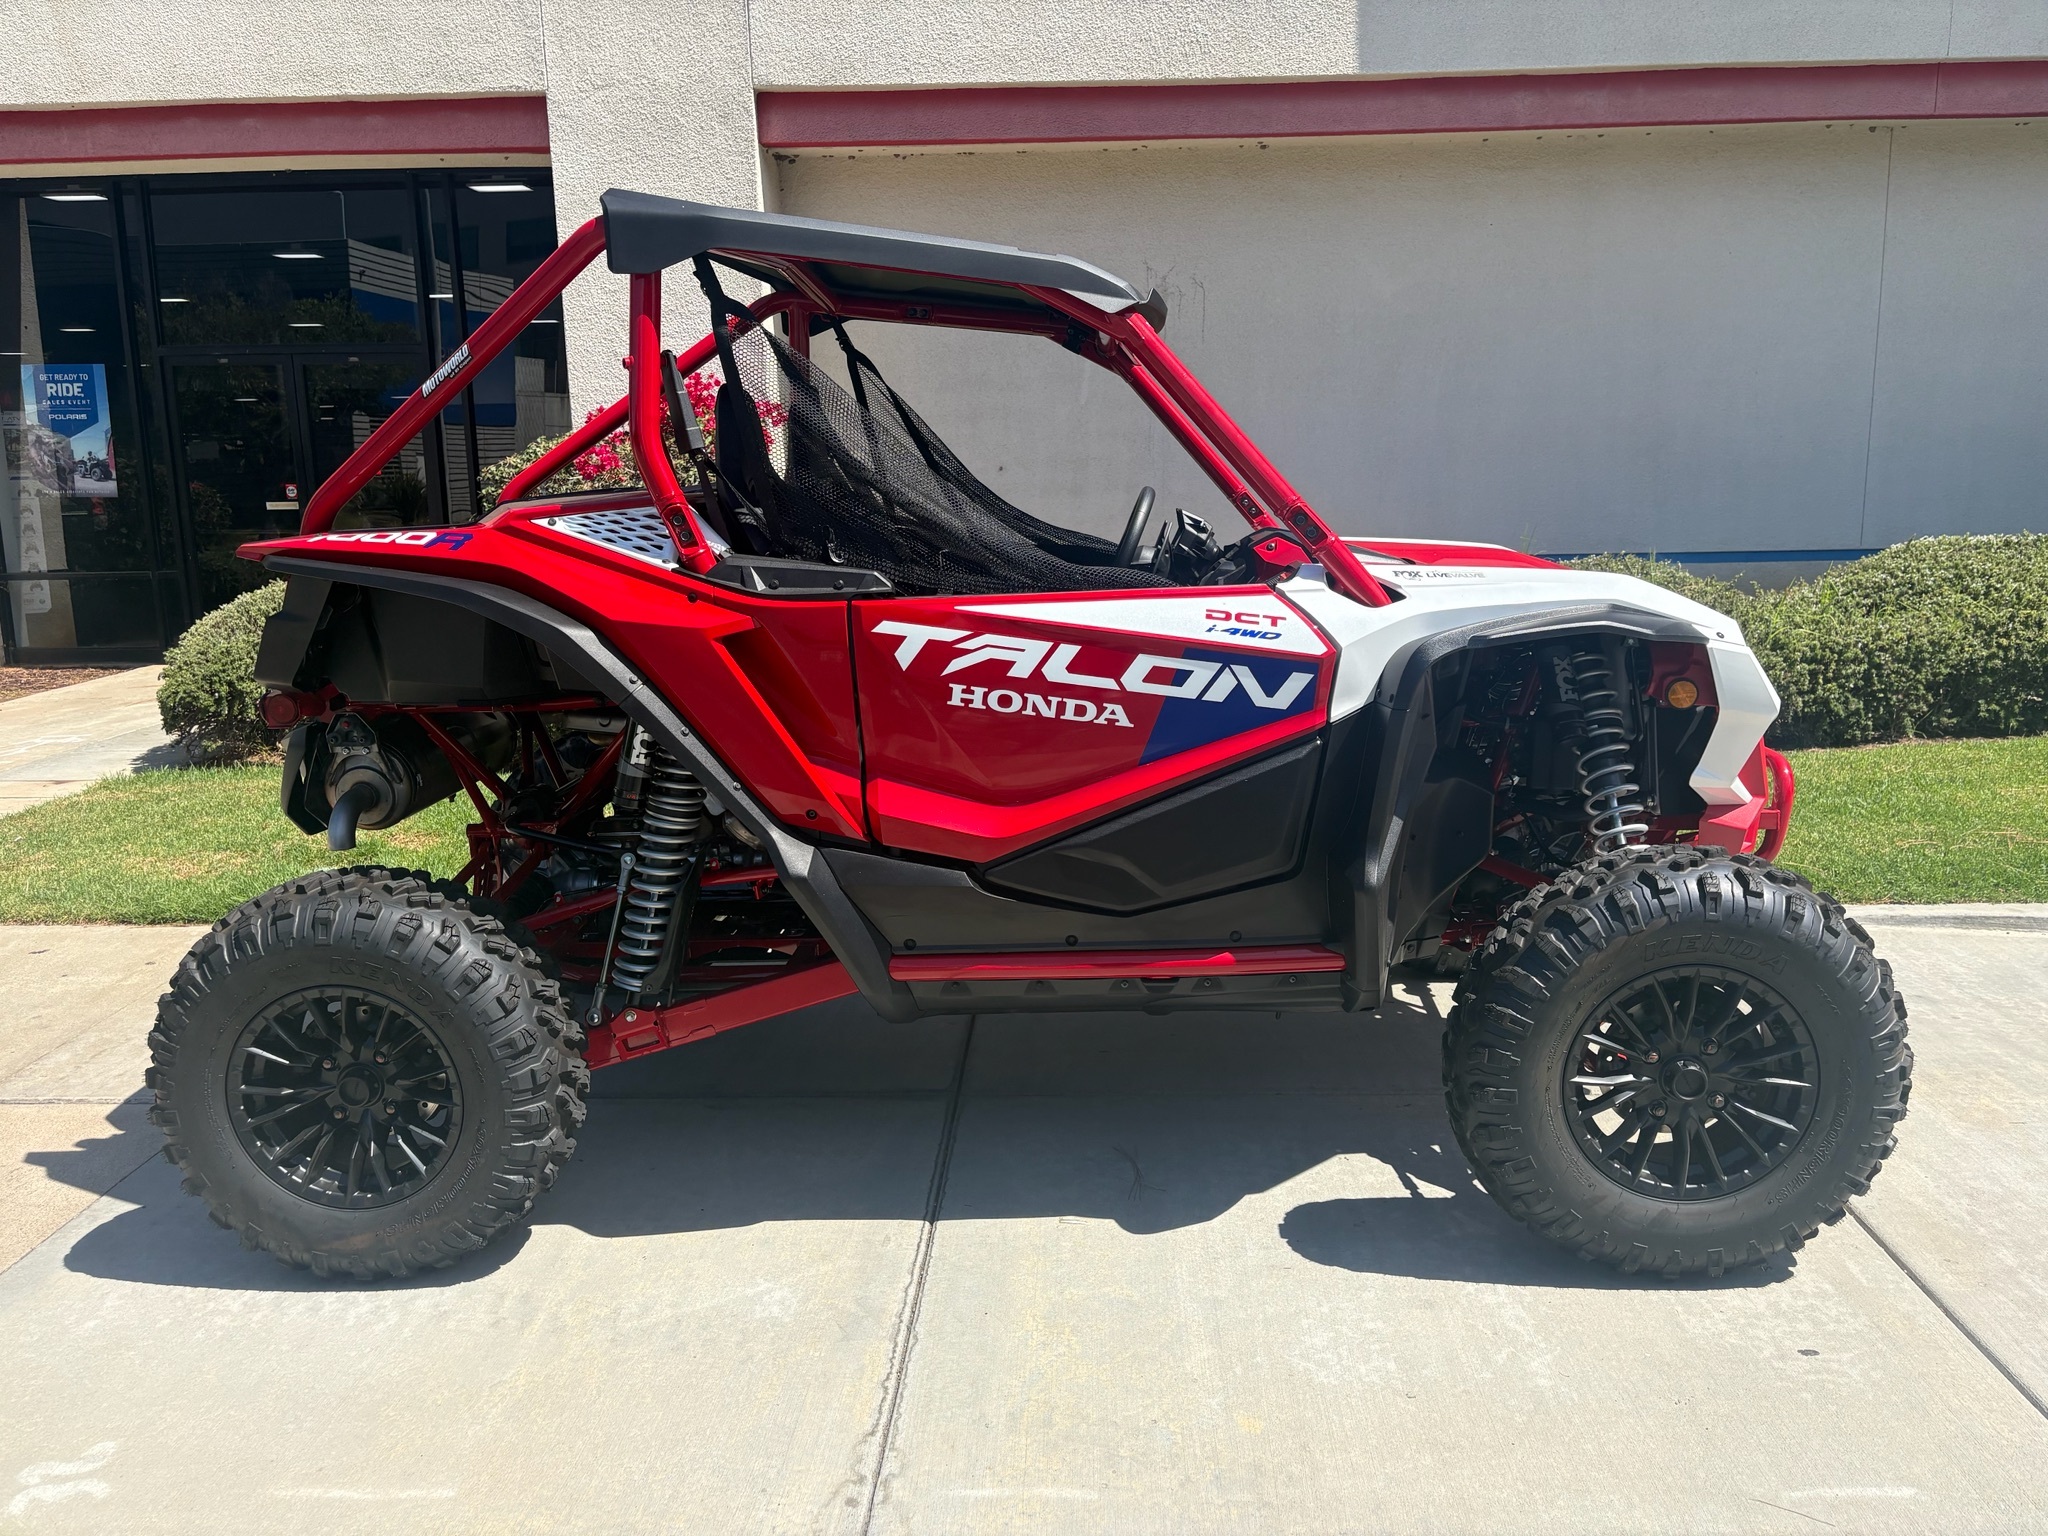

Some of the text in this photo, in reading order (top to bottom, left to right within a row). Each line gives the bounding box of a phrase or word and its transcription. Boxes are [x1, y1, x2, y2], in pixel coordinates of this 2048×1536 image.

[46, 383, 84, 397] RIDE
[422, 344, 469, 397] MOTOWORLD
[1392, 571, 1423, 581] FOX
[1205, 609, 1287, 627] DCT
[871, 620, 1315, 710] TALON
[1553, 656, 1579, 702] FOX
[946, 683, 1134, 728] HONDA
[630, 724, 656, 767] FO
[1643, 933, 1790, 976] KENDA
[329, 956, 455, 1029] KENDA
